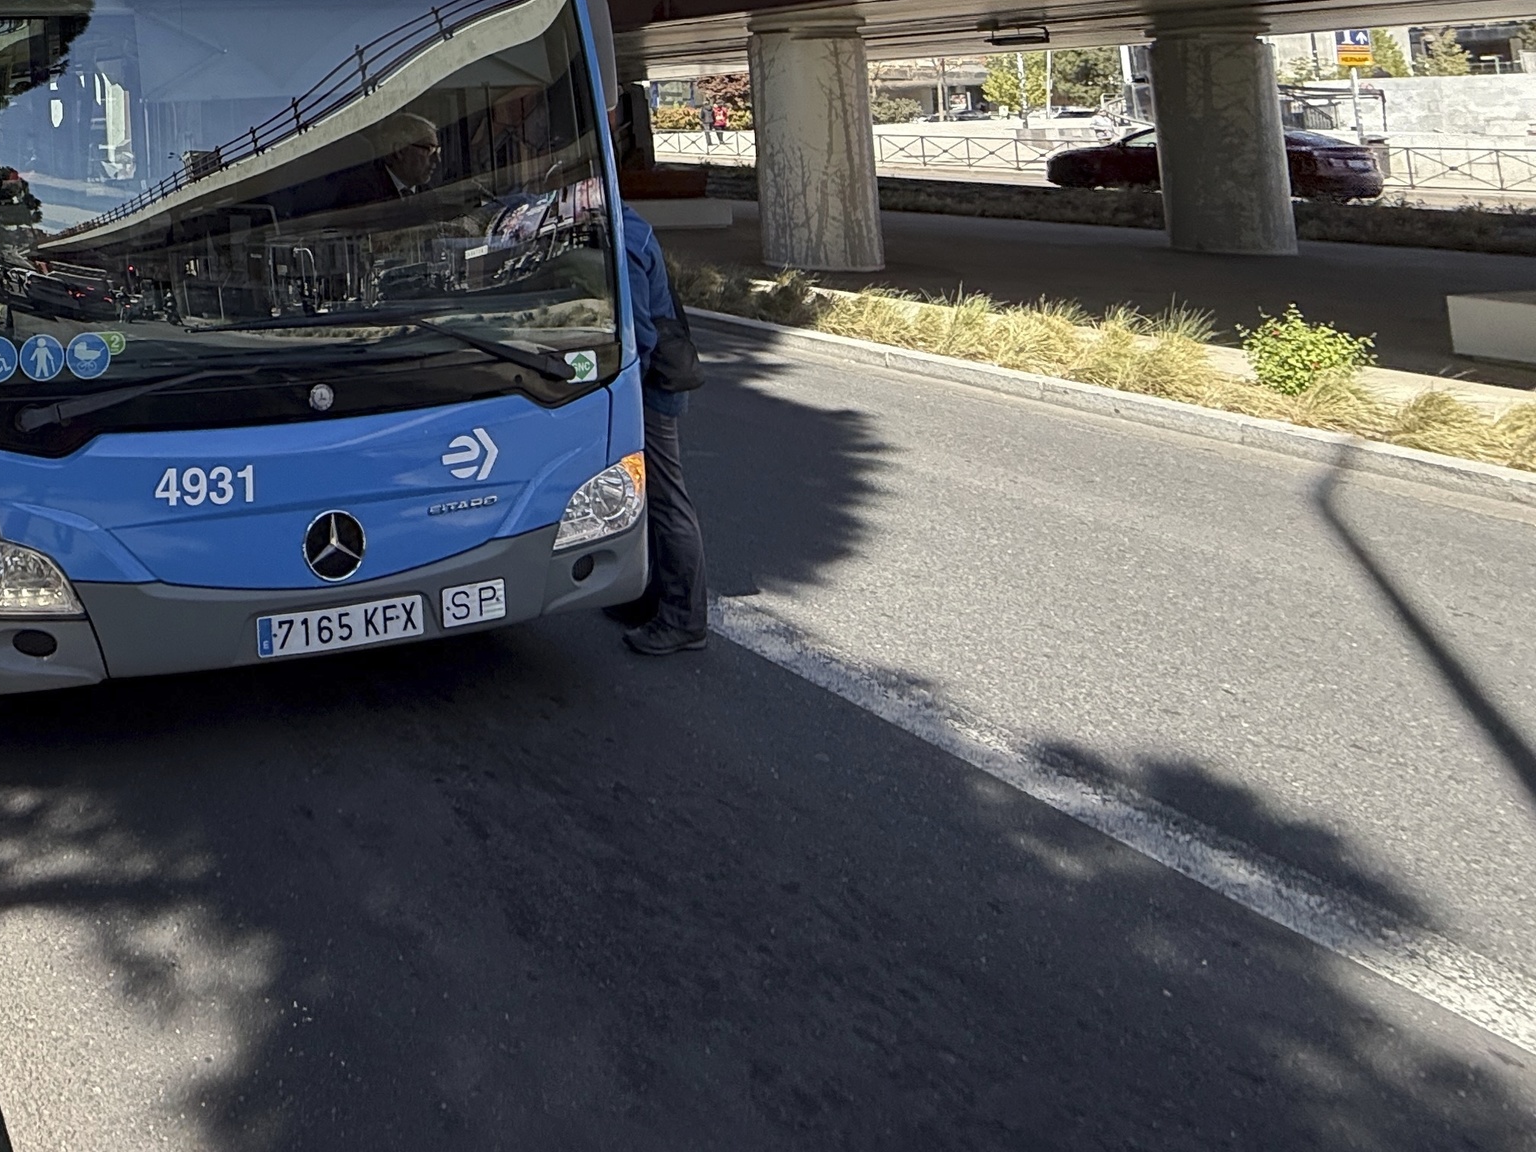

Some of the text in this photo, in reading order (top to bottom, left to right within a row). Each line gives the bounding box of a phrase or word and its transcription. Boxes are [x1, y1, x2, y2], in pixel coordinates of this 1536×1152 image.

[110, 335, 120, 348] 2
[154, 464, 254, 507] 4931
[450, 585, 497, 620] SP
[277, 601, 418, 650] 7165 KFX
